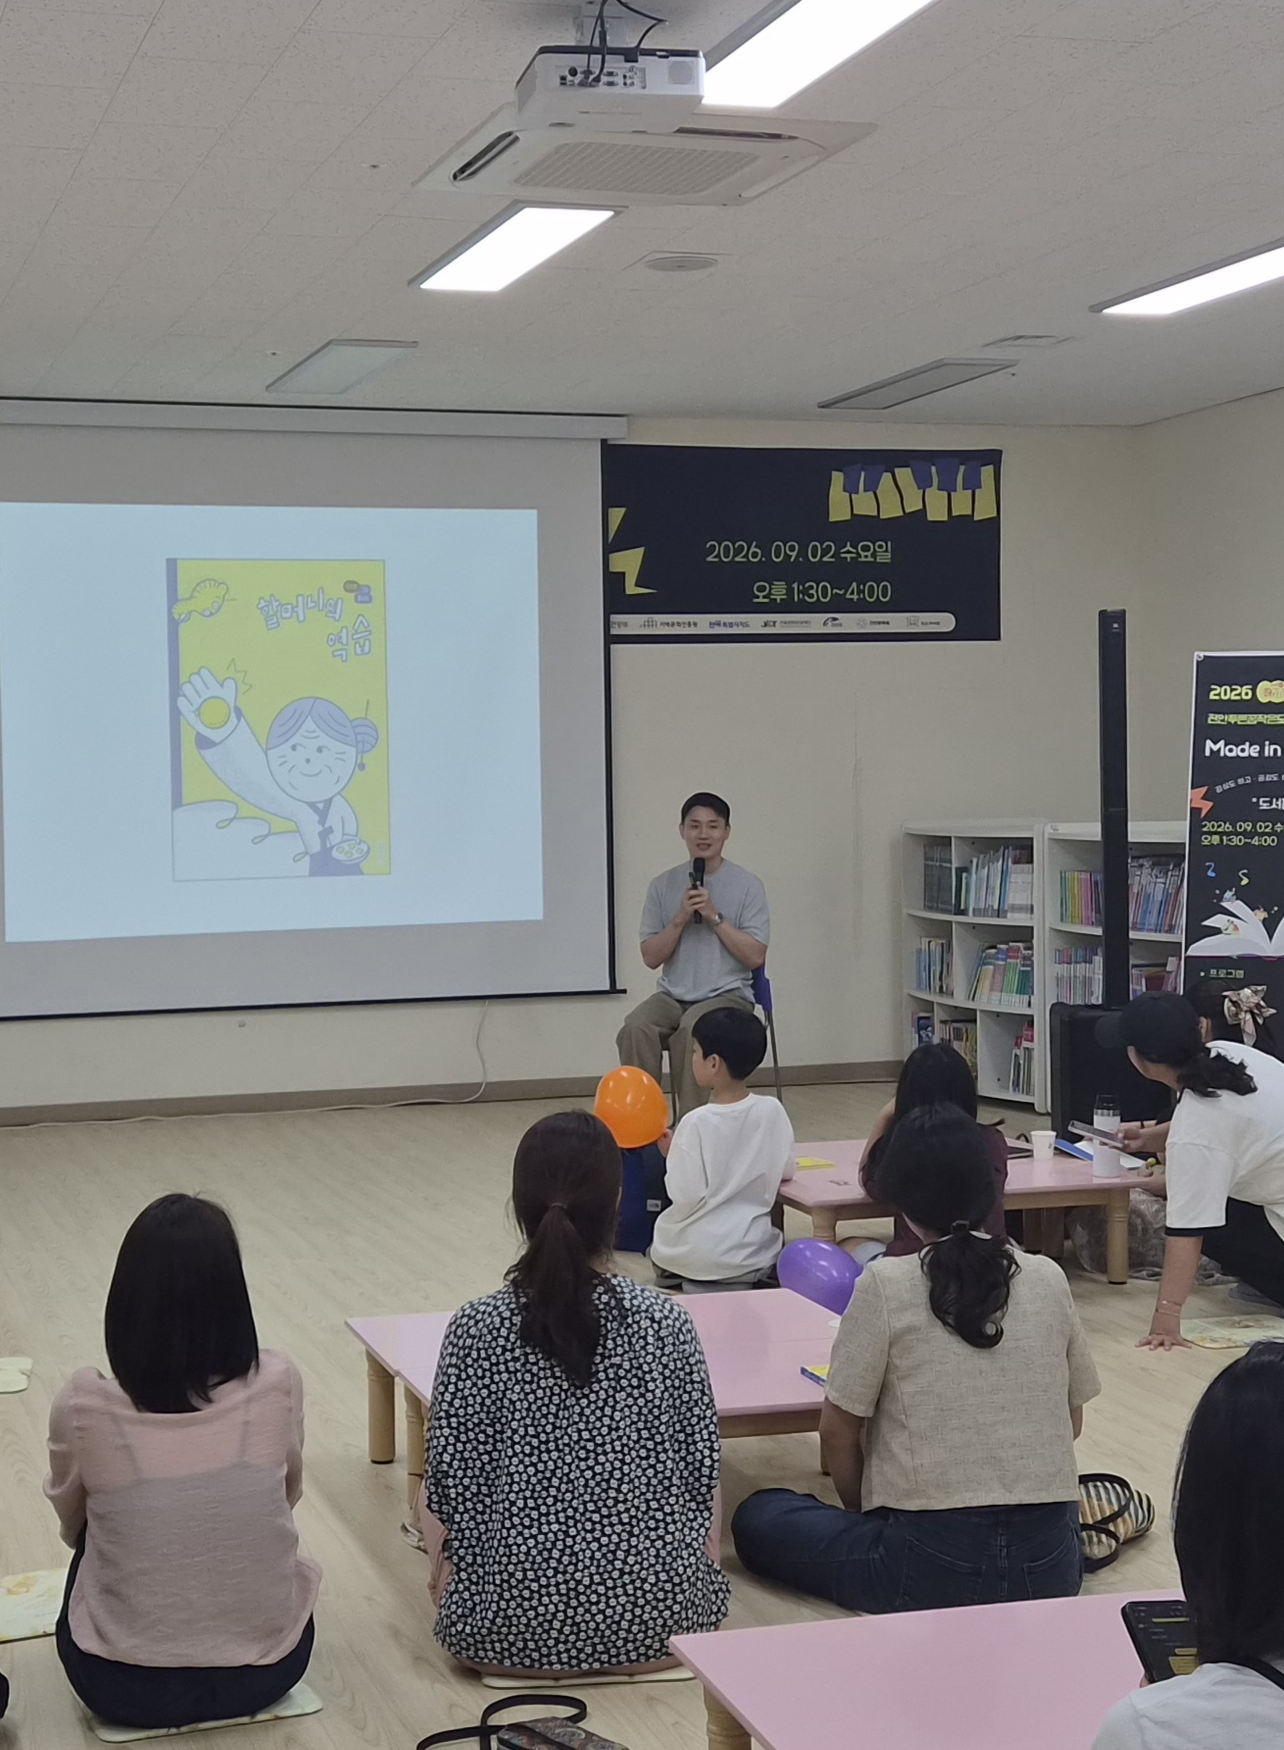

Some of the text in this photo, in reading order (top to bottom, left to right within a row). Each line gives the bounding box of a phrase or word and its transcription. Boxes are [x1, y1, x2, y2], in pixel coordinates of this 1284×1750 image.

[705, 540, 892, 563] 2026. 09. 02 수요일
[752, 581, 892, 603] 오후 1:30~4:00
[257, 587, 344, 630] 할머니의
[1209, 685, 1253, 700] 2026
[1204, 738, 1261, 757] Made
[1264, 740, 1282, 757] in
[1201, 821, 1235, 832] 2026.
[1236, 821, 1255, 832] 09.
[1256, 821, 1273, 832] 02
[1201, 835, 1221, 846] 오후
